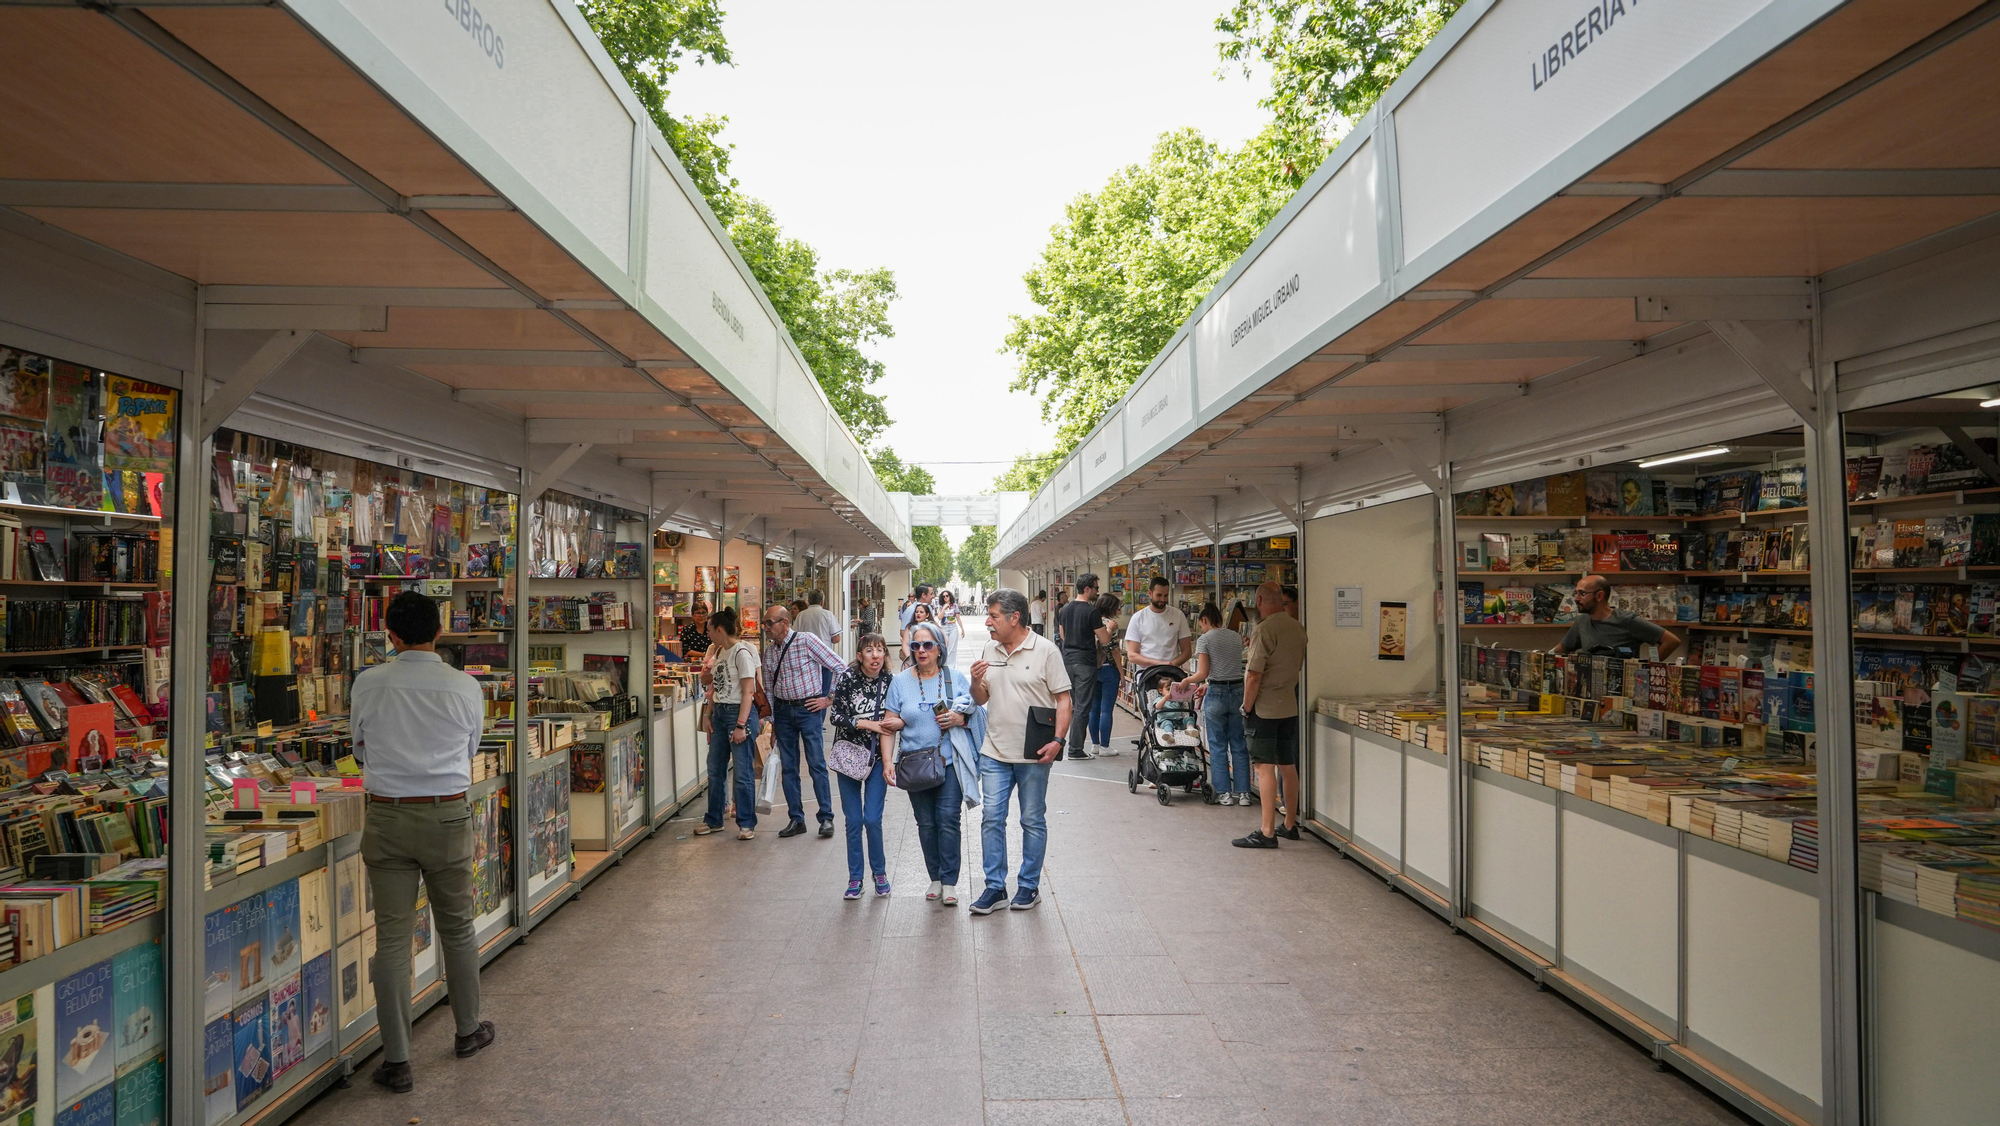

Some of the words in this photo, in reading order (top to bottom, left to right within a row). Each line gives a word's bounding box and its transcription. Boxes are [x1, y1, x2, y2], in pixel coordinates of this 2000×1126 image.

[1252, 298, 1273, 329] MIGUEL
[1273, 273, 1300, 310] URBANO
[131, 382, 170, 396] ALBUM
[118, 396, 167, 417] POPEYE
[1780, 485, 1801, 498] CIELO
[236, 894, 263, 920] ARCO
[231, 916, 244, 938] DE
[246, 908, 267, 930] BERA
[57, 971, 96, 1001] CASTILLO
[98, 963, 112, 982] DE
[65, 985, 104, 1017] BELLVER
[239, 1001, 264, 1027] COSMOS
